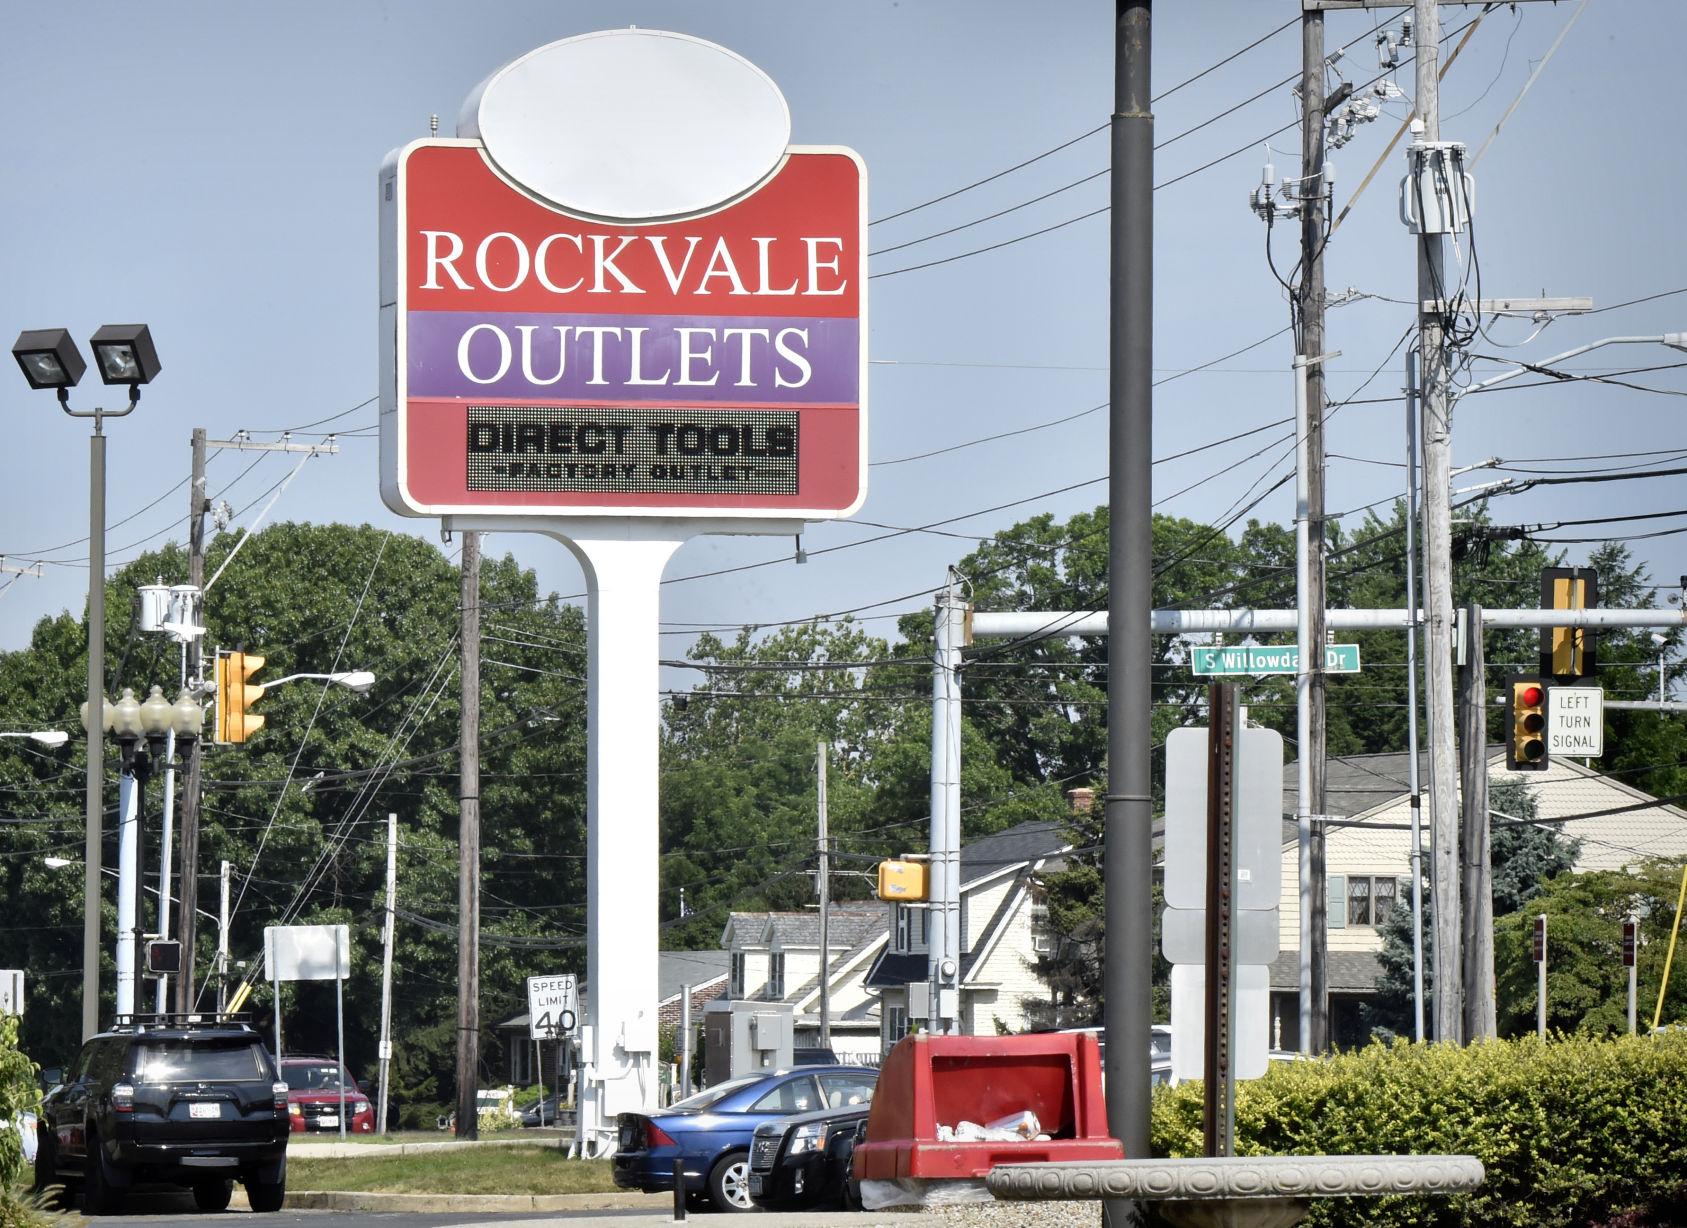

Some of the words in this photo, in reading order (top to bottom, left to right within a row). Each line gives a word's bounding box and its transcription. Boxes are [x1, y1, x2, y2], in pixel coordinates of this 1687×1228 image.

[418, 230, 847, 296] ROCKVALE
[457, 324, 812, 388] OUTLETS
[469, 421, 634, 454] DIRECT
[647, 423, 795, 457] TOOLS
[1205, 653, 1216, 668] S
[1222, 651, 1298, 668] Willowda
[1327, 650, 1346, 667] Dr
[1560, 696, 1589, 709] LEFT
[1559, 715, 1591, 728] TURN
[1553, 734, 1595, 748] SIGNAL
[532, 980, 573, 992] SPEED
[538, 995, 569, 1007] LIMIT
[535, 1010, 576, 1033] 40
